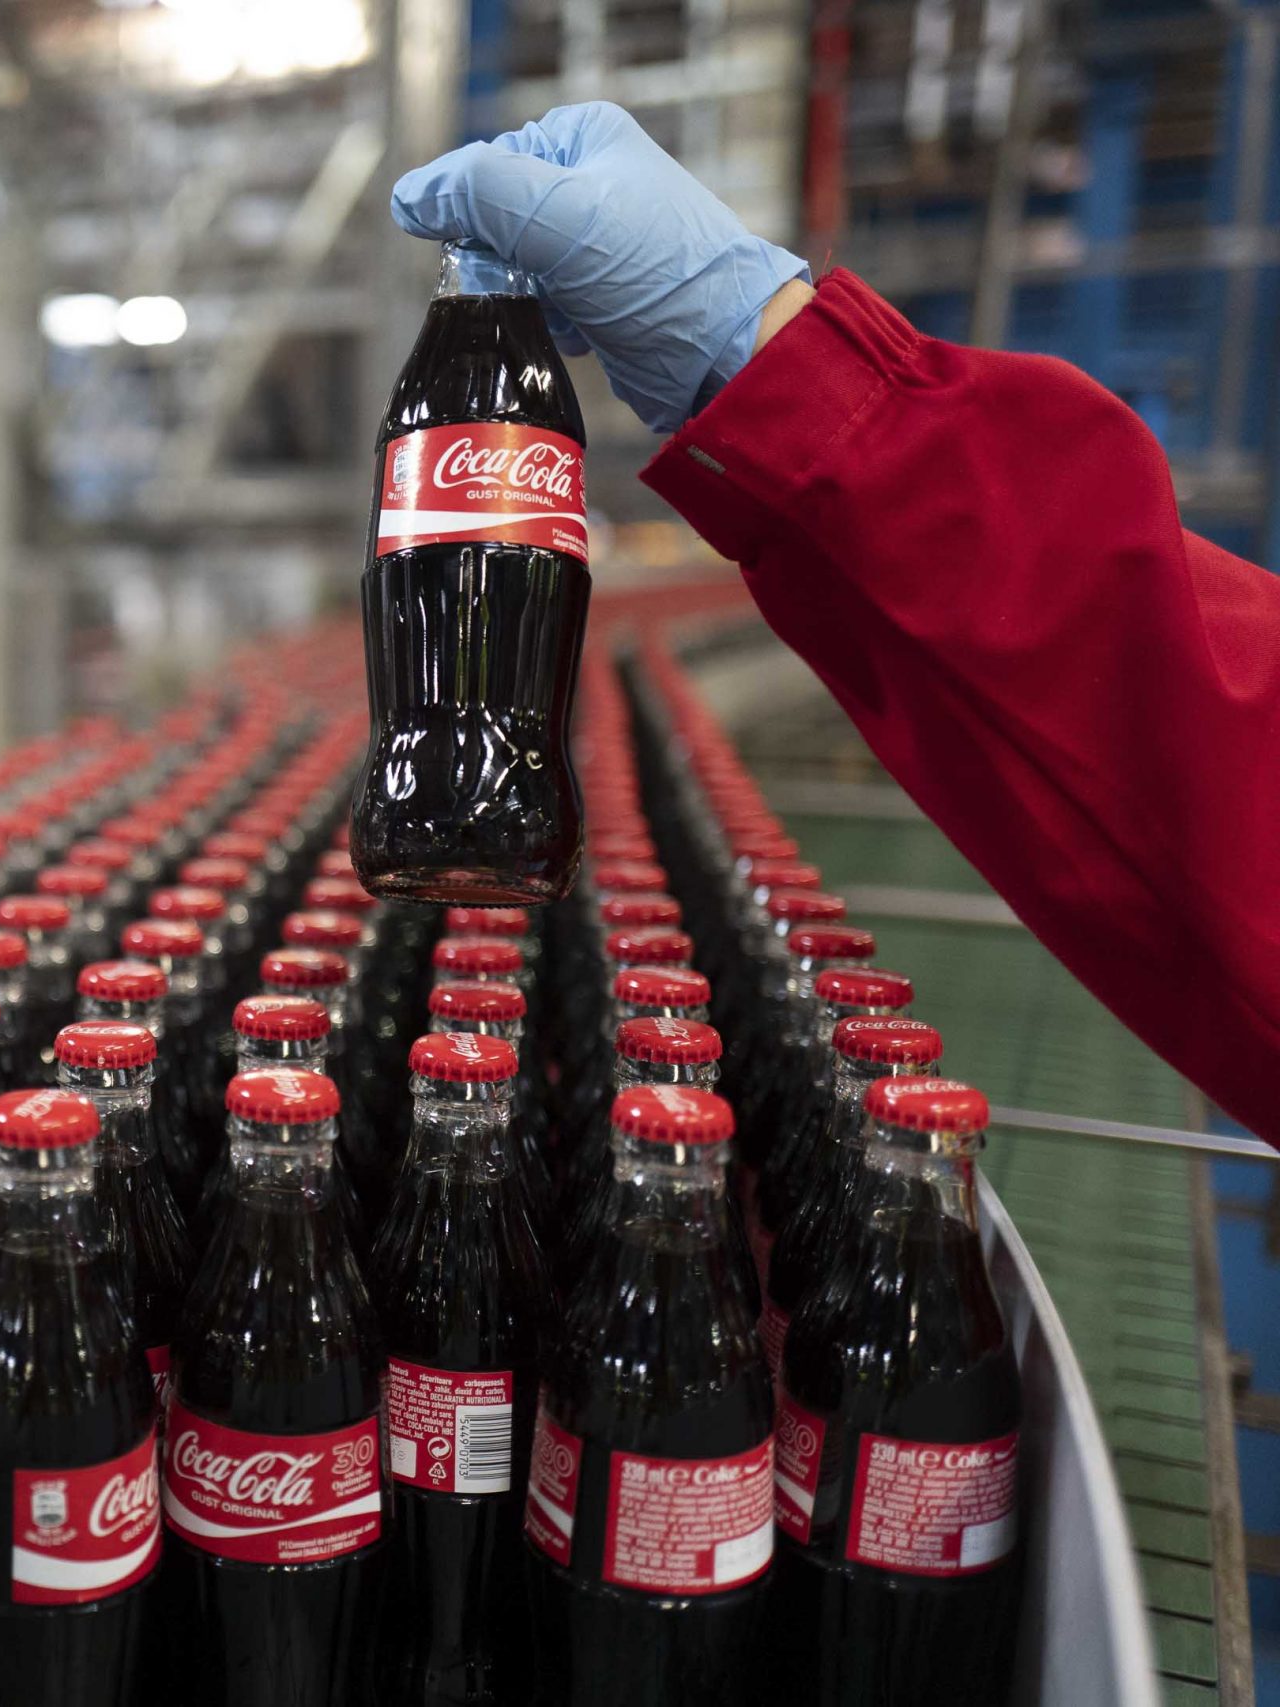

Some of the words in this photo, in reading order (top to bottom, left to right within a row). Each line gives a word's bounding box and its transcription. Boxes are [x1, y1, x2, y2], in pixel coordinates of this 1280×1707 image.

[433, 438, 575, 498] Coca-Cola
[466, 489, 500, 500] GUST
[503, 490, 556, 508] ORIGINAL
[846, 1018, 931, 1032] Coca-Cola
[883, 1080, 968, 1099] Coca-Cola
[407, 1419, 439, 1434] COCA-COLA
[331, 1435, 375, 1475] 30
[871, 1442, 897, 1464] 330
[897, 1449, 916, 1467] ml
[944, 1449, 993, 1470] Coke
[173, 1430, 325, 1507] Coca-Cola
[693, 1464, 740, 1487] Coke
[191, 1489, 220, 1509] GUST
[222, 1503, 284, 1521] ORIGINAL
